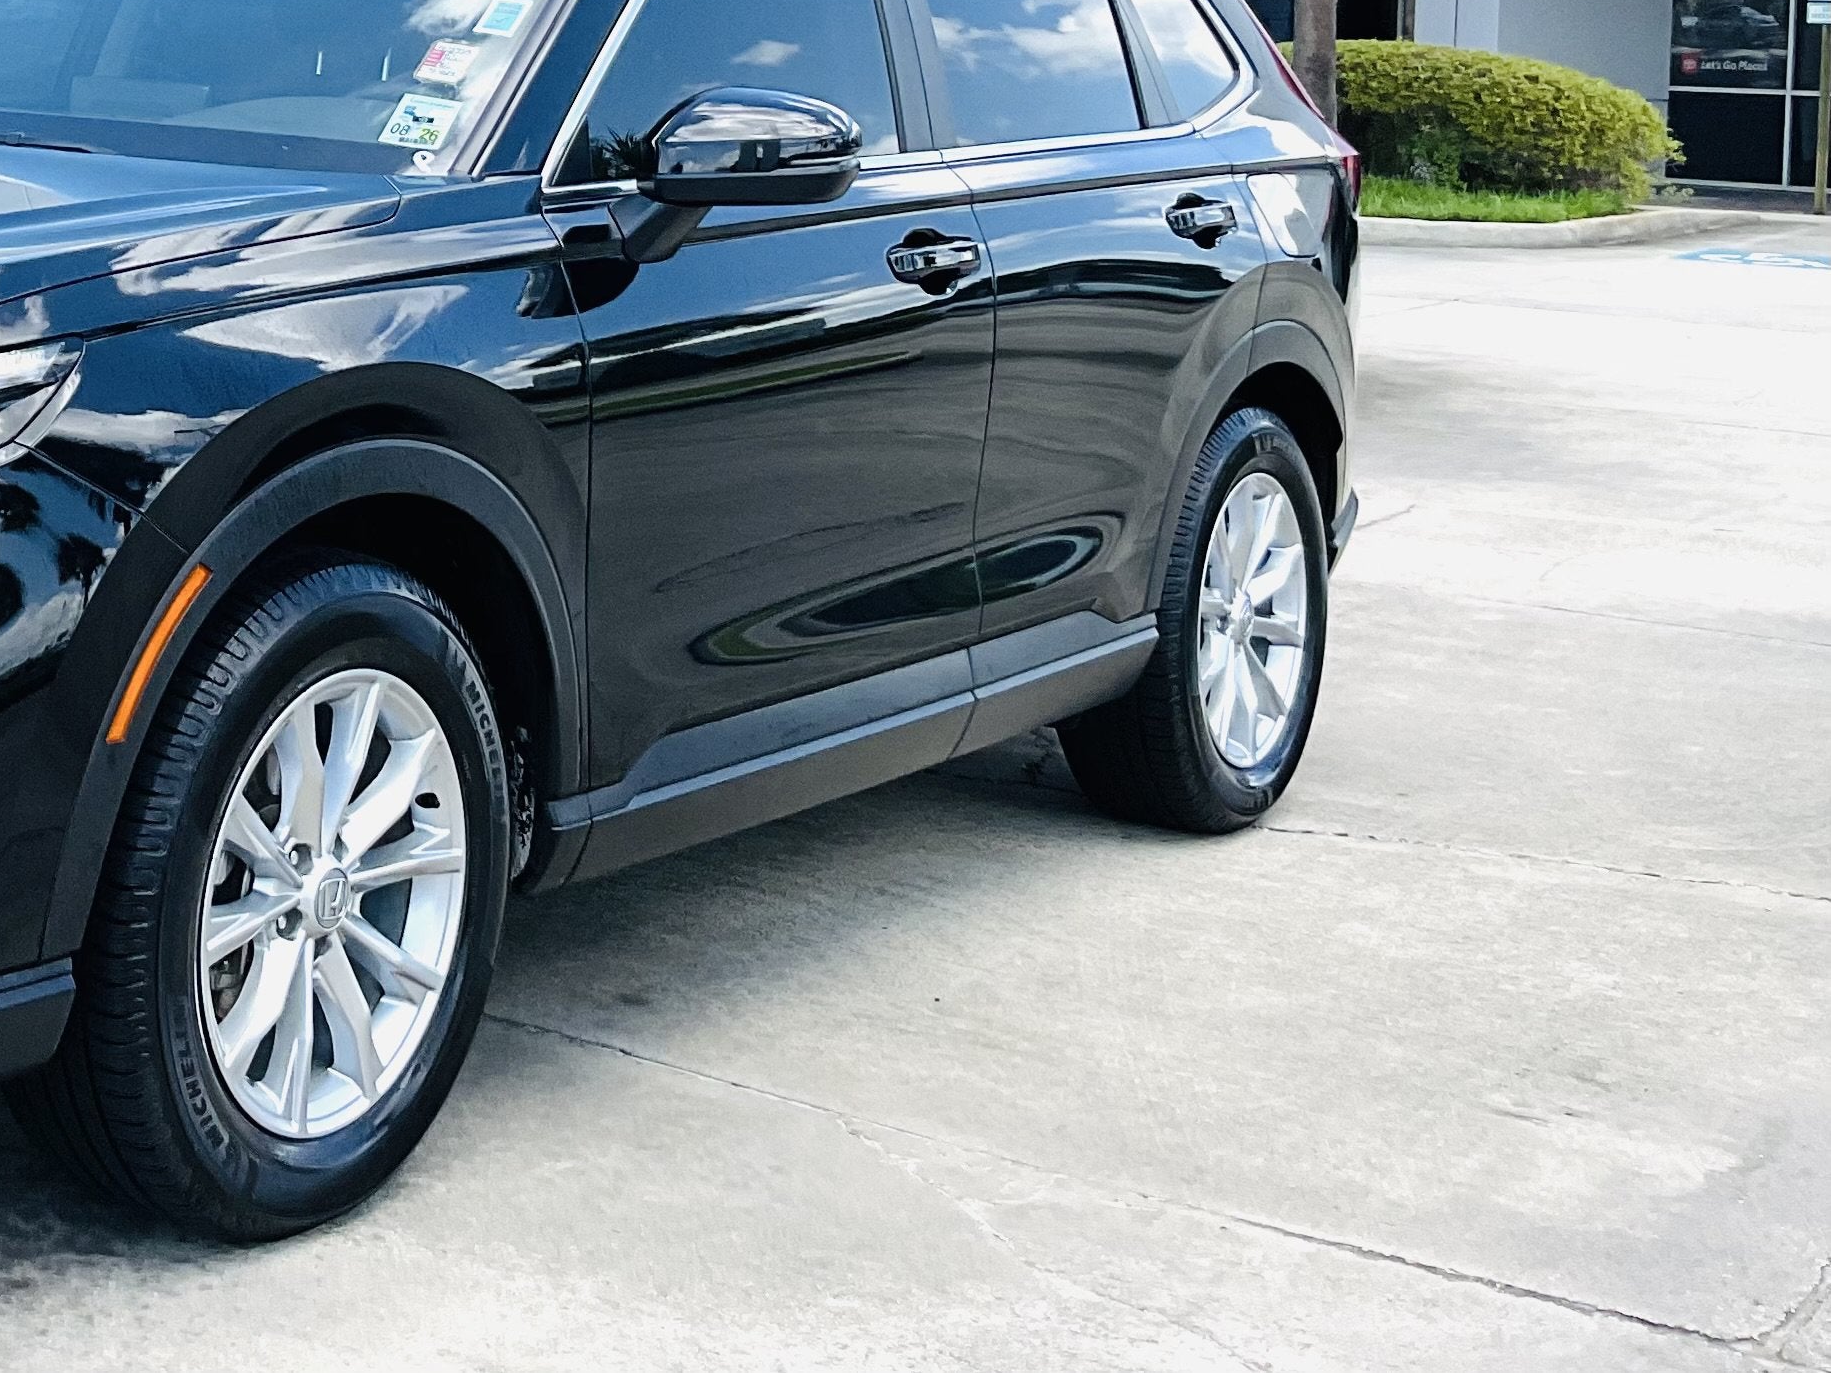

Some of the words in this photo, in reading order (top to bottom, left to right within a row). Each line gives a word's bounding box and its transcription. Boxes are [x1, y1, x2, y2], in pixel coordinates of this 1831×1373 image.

[1723, 60, 1737, 70] Go
[390, 122, 411, 136] 08
[418, 128, 440, 143] 26
